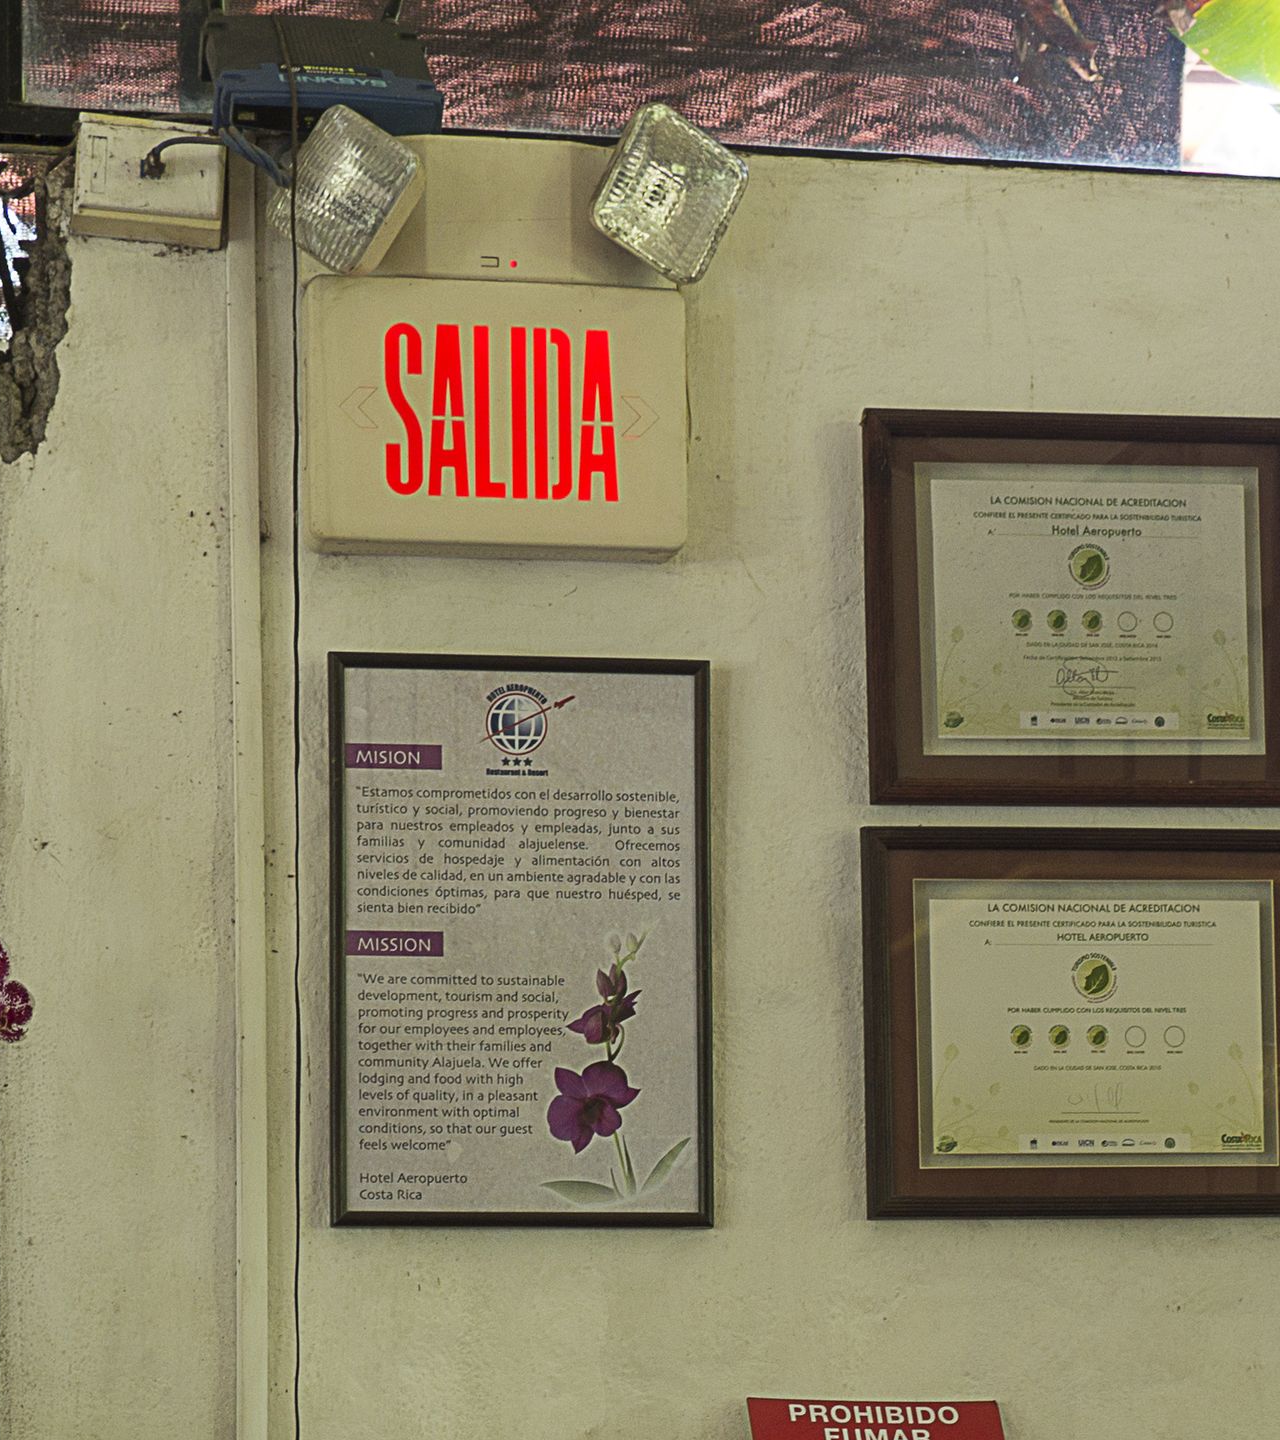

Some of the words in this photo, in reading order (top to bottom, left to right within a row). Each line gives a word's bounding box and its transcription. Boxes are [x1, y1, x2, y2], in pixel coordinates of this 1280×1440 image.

[384, 322, 619, 502] SALIDA
[990, 496, 1002, 505] LA
[1004, 496, 1053, 506] COMISION
[1055, 498, 1104, 506] NACIONAL
[1106, 498, 1118, 507] DE
[1120, 498, 1187, 508] ACREDITACION
[1052, 525, 1079, 536] Hotel
[1082, 526, 1142, 539] Aeropuerto
[356, 751, 420, 764] MISION
[416, 788, 512, 801] comprometidos
[515, 792, 536, 800] con
[540, 789, 550, 800] el
[553, 789, 613, 802] desarrollo
[616, 792, 679, 804] sostenible,
[357, 803, 408, 814] turístico
[413, 806, 420, 817] y
[426, 804, 463, 817] social,
[468, 805, 549, 818] promoviendo
[554, 808, 607, 820] progreso
[612, 810, 619, 820] y
[625, 807, 680, 819] bienestar
[357, 822, 383, 836] para
[391, 821, 443, 831] nuestros
[450, 821, 514, 835] empleados
[521, 825, 528, 835] y
[535, 822, 602, 836] empleadas,
[608, 824, 641, 837] junto
[648, 826, 654, 835] a
[661, 827, 680, 835] sus
[357, 835, 405, 847] familias
[418, 839, 425, 850] y
[438, 838, 505, 849] comunidad
[519, 838, 588, 852] alajuelense.
[615, 840, 680, 852] Ofrecemos
[357, 852, 409, 864] servicios
[419, 853, 434, 864] de
[444, 853, 504, 868] hospedaje
[514, 858, 522, 868] y
[532, 855, 610, 867] alimentación
[620, 859, 641, 867] con
[651, 857, 680, 868] altos
[358, 869, 399, 880] niveles
[402, 869, 417, 880] de
[420, 870, 466, 882] calidad,
[470, 873, 484, 881] en
[488, 873, 503, 882] un
[507, 871, 564, 883] ambiente
[567, 872, 626, 886] agradable
[629, 876, 636, 886] y
[640, 875, 661, 884] con
[665, 873, 680, 884] las
[357, 886, 429, 897] condiciones
[435, 886, 487, 900] óptimas,
[494, 890, 520, 901] para
[527, 890, 549, 901] que
[556, 890, 602, 900] nuestro
[609, 889, 662, 903] huésped,
[668, 892, 681, 901] se
[358, 902, 394, 913] sienta
[398, 902, 424, 914] bien
[988, 904, 1000, 912] LA
[1002, 904, 1055, 913] COMISION
[1058, 904, 1111, 913] NACIONAL
[1114, 904, 1126, 913] DE
[1129, 904, 1200, 913] ACREDITACION
[1057, 933, 1087, 941] HOTEL
[1089, 933, 1149, 941] AEROPUERTO
[358, 938, 430, 952] MISSION
[388, 976, 407, 984] are
[410, 974, 477, 986] committed
[481, 976, 494, 986] to
[498, 975, 565, 986] sustainable
[358, 990, 442, 1004] development,
[445, 992, 493, 1002] tourism
[496, 991, 518, 1003] and
[522, 992, 559, 1004] social,
[358, 1007, 423, 1021] promoting
[427, 1010, 478, 1021] progress
[482, 1008, 504, 1019] and
[508, 1009, 569, 1022] prosperity
[358, 1023, 377, 1034] for
[380, 1026, 401, 1034] our
[404, 1024, 469, 1037] employees
[472, 1024, 495, 1035] and
[498, 1024, 566, 1038] employees,
[358, 1040, 412, 1054] together
[416, 1040, 443, 1051] with
[447, 1040, 476, 1051] their
[479, 1040, 526, 1052] families
[530, 1041, 552, 1052] and
[358, 1057, 429, 1070] community
[432, 1056, 485, 1070] Alajuela.
[488, 1058, 509, 1068] We
[513, 1057, 543, 1068] offer
[359, 1072, 404, 1087] lodging
[408, 1073, 430, 1084] and
[434, 1073, 462, 1085] food
[466, 1074, 493, 1084] with
[497, 1074, 523, 1088] high
[359, 1089, 393, 1101] levels
[396, 1089, 410, 1101] of
[413, 1090, 459, 1104] quality,
[463, 1090, 474, 1101] in
[478, 1093, 484, 1101] a
[488, 1090, 538, 1104] pleasant
[358, 1106, 438, 1117] environment
[442, 1106, 470, 1117] with
[473, 1107, 519, 1120] optimal
[359, 1122, 426, 1135] conditions,
[430, 1126, 443, 1134] so
[447, 1123, 472, 1134] that
[476, 1126, 497, 1134] our
[500, 1125, 533, 1137] guest
[359, 1138, 388, 1150] feels
[360, 1172, 394, 1183] Hotel
[397, 1173, 468, 1186] Aeropuerto
[360, 1189, 393, 1200] Costa
[398, 1189, 422, 1200] Rica
[789, 1404, 959, 1424] PROHIBIDO
